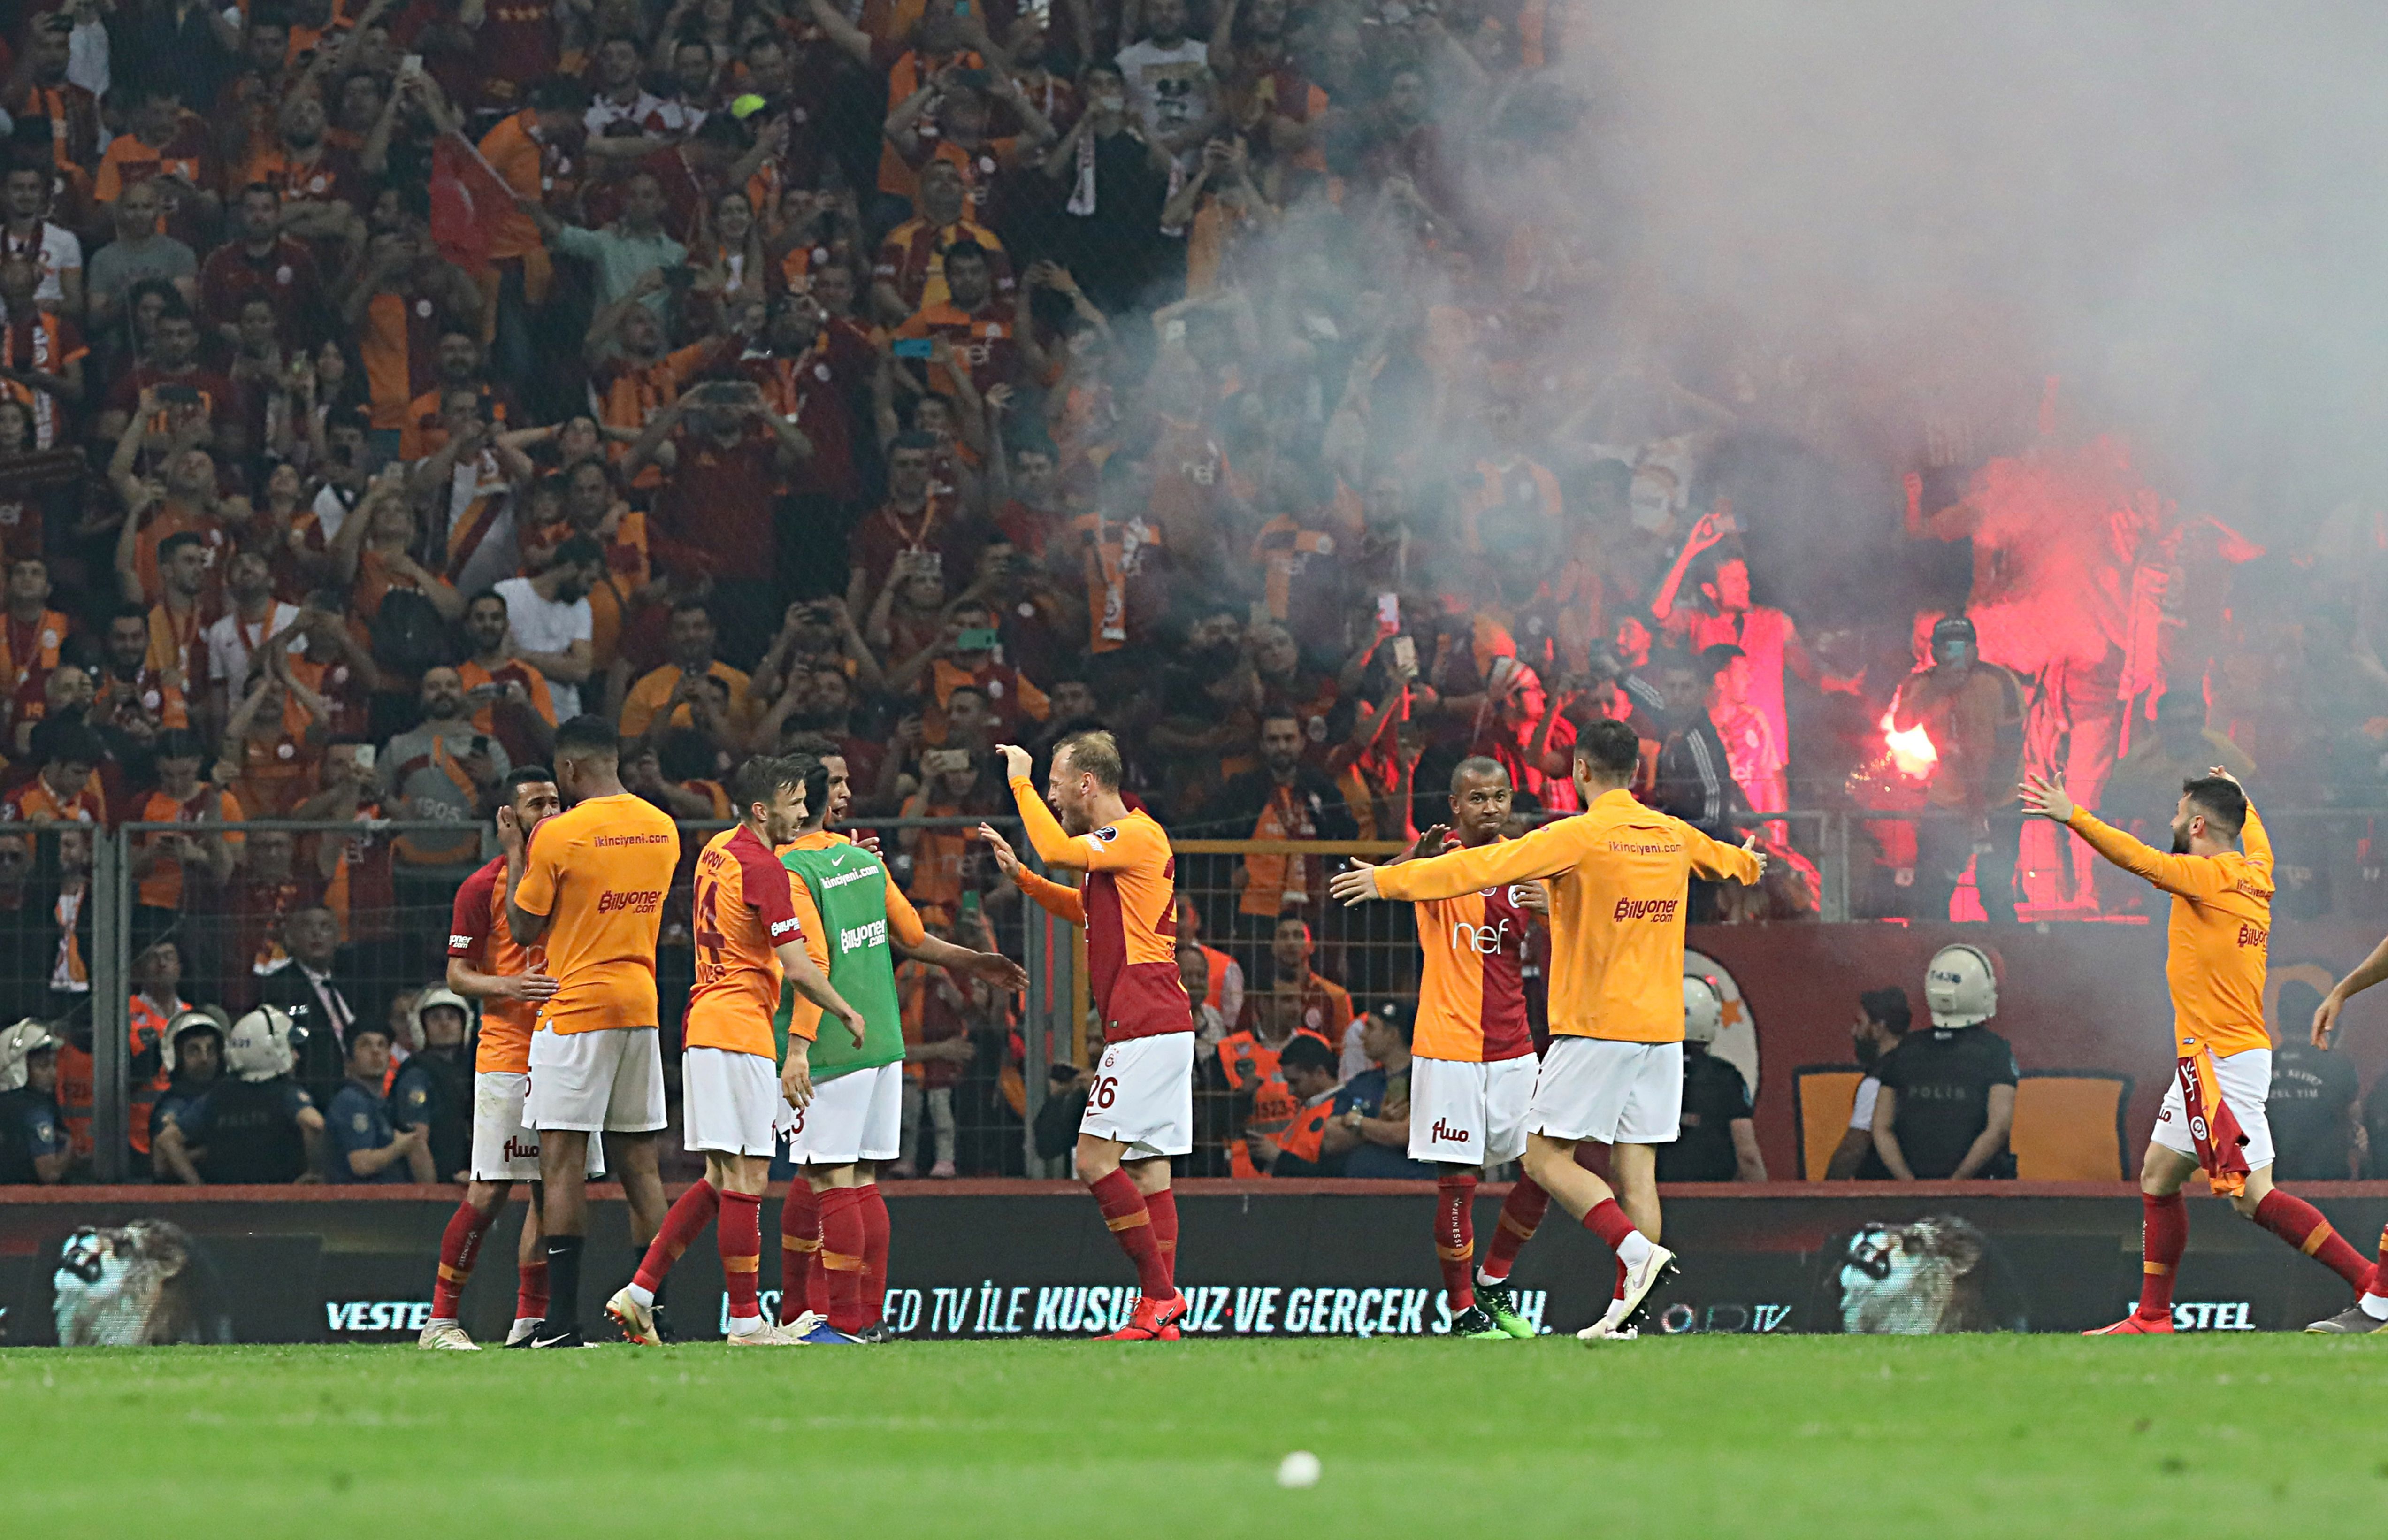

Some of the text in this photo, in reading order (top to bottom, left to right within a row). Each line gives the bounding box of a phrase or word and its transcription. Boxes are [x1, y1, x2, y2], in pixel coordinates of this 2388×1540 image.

[595, 833, 669, 847] ikinciyeni.com
[1609, 841, 1681, 856] ikinciyeni.com
[597, 890, 662, 914] Bilyoner
[1613, 897, 1678, 923] Bilyoner
[1650, 913, 1673, 923] .com
[840, 919, 886, 954] Bilyoner
[1452, 918, 1509, 955] nef
[1087, 1074, 1118, 1109] 26
[931, 1287, 972, 1333] TV
[974, 1279, 1031, 1333] İLE
[1234, 1286, 1282, 1333] VE
[1284, 1287, 1429, 1338] GERÇEK
[1753, 1302, 1792, 1332] TV
